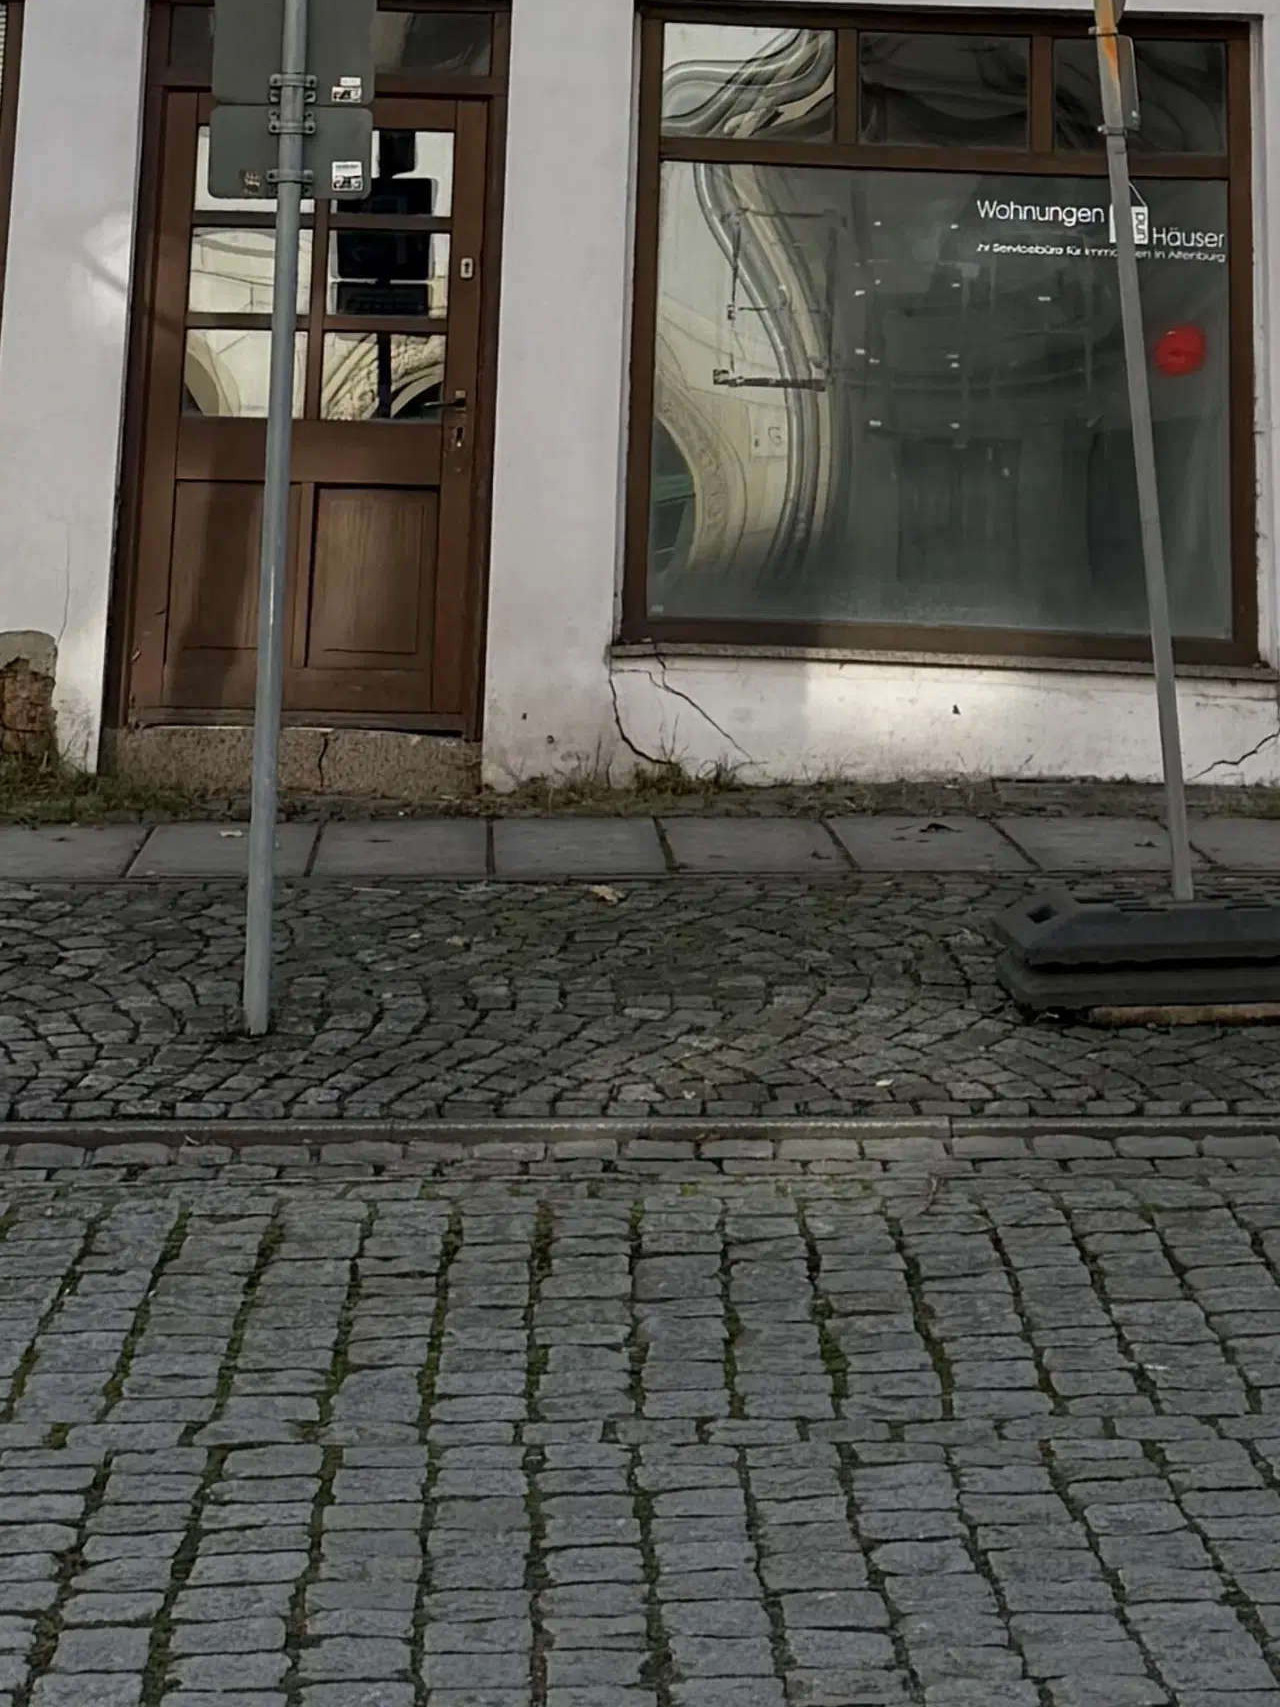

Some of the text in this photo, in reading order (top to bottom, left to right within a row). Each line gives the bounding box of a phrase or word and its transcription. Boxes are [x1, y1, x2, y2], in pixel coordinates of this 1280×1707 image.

[976, 200, 1225, 248] Wohnungen und Häuser
